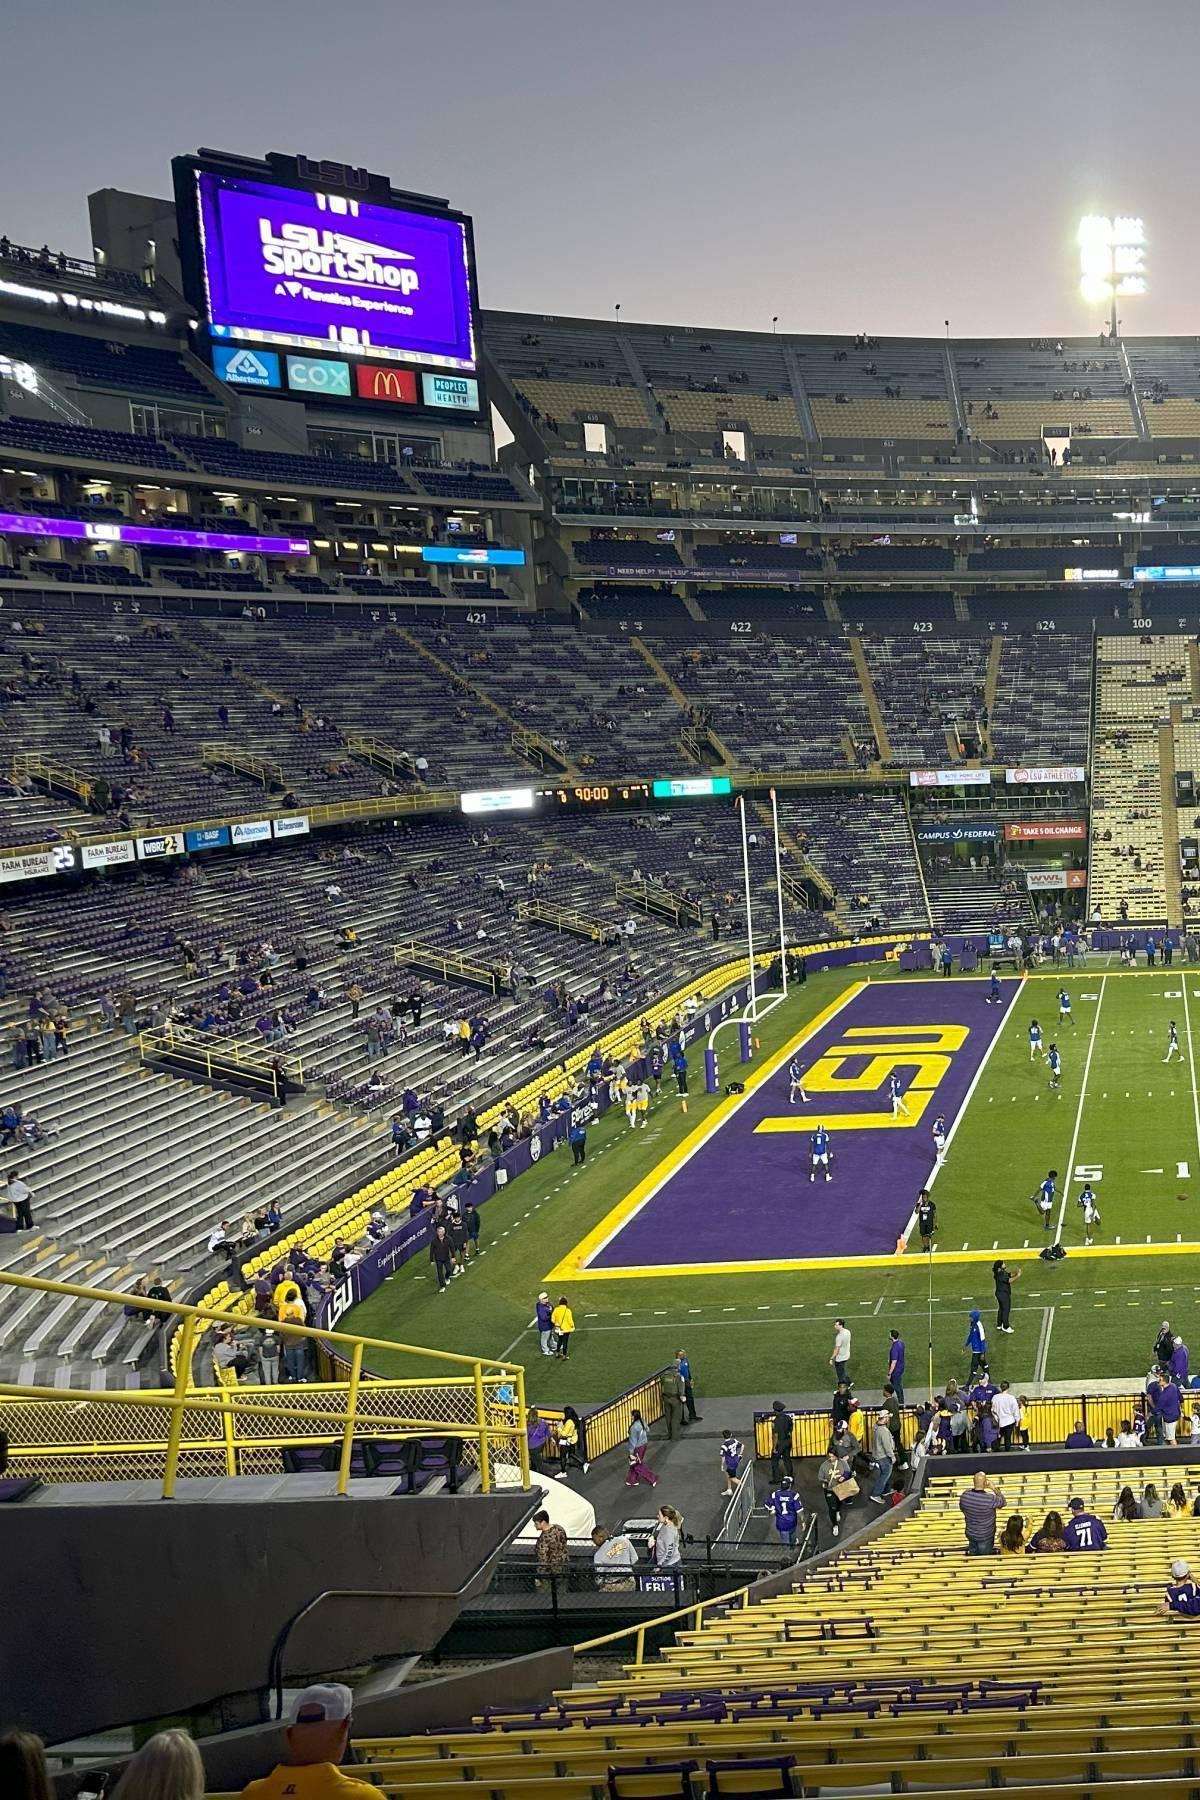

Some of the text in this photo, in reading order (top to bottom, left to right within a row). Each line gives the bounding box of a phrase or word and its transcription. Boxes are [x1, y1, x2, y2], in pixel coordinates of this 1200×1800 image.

[296, 154, 369, 191] LSU
[259, 218, 334, 252] LSU
[262, 245, 420, 295] SportShop
[303, 286, 351, 306] Fanatics
[352, 297, 414, 316] Experience
[225, 373, 270, 386] Albertsons
[289, 364, 348, 389] COX
[436, 378, 467, 393] PEOPLES
[85, 523, 121, 540] LSU
[466, 613, 487, 624] 421
[1132, 618, 1152, 628] 100
[730, 622, 752, 632] 422
[913, 622, 933, 632] 423
[1043, 771, 1078, 781] ATHLETICS
[575, 787, 608, 801] 90:00
[918, 830, 997, 840] CAMPUS FEDERAL
[1054, 826, 1082, 834] CHANGE
[88, 844, 128, 858] FARM BUREAU
[144, 841, 165, 853] WBRZ
[1, 855, 49, 871] FARM BUREAU
[52, 846, 75, 869] 25
[752, 1024, 970, 1134] LSU
[1073, 1164, 1103, 1182] 5
[328, 1275, 354, 1331] LSU
[780, 1502, 788, 1515] 1
[1076, 1527, 1093, 1547] 71
